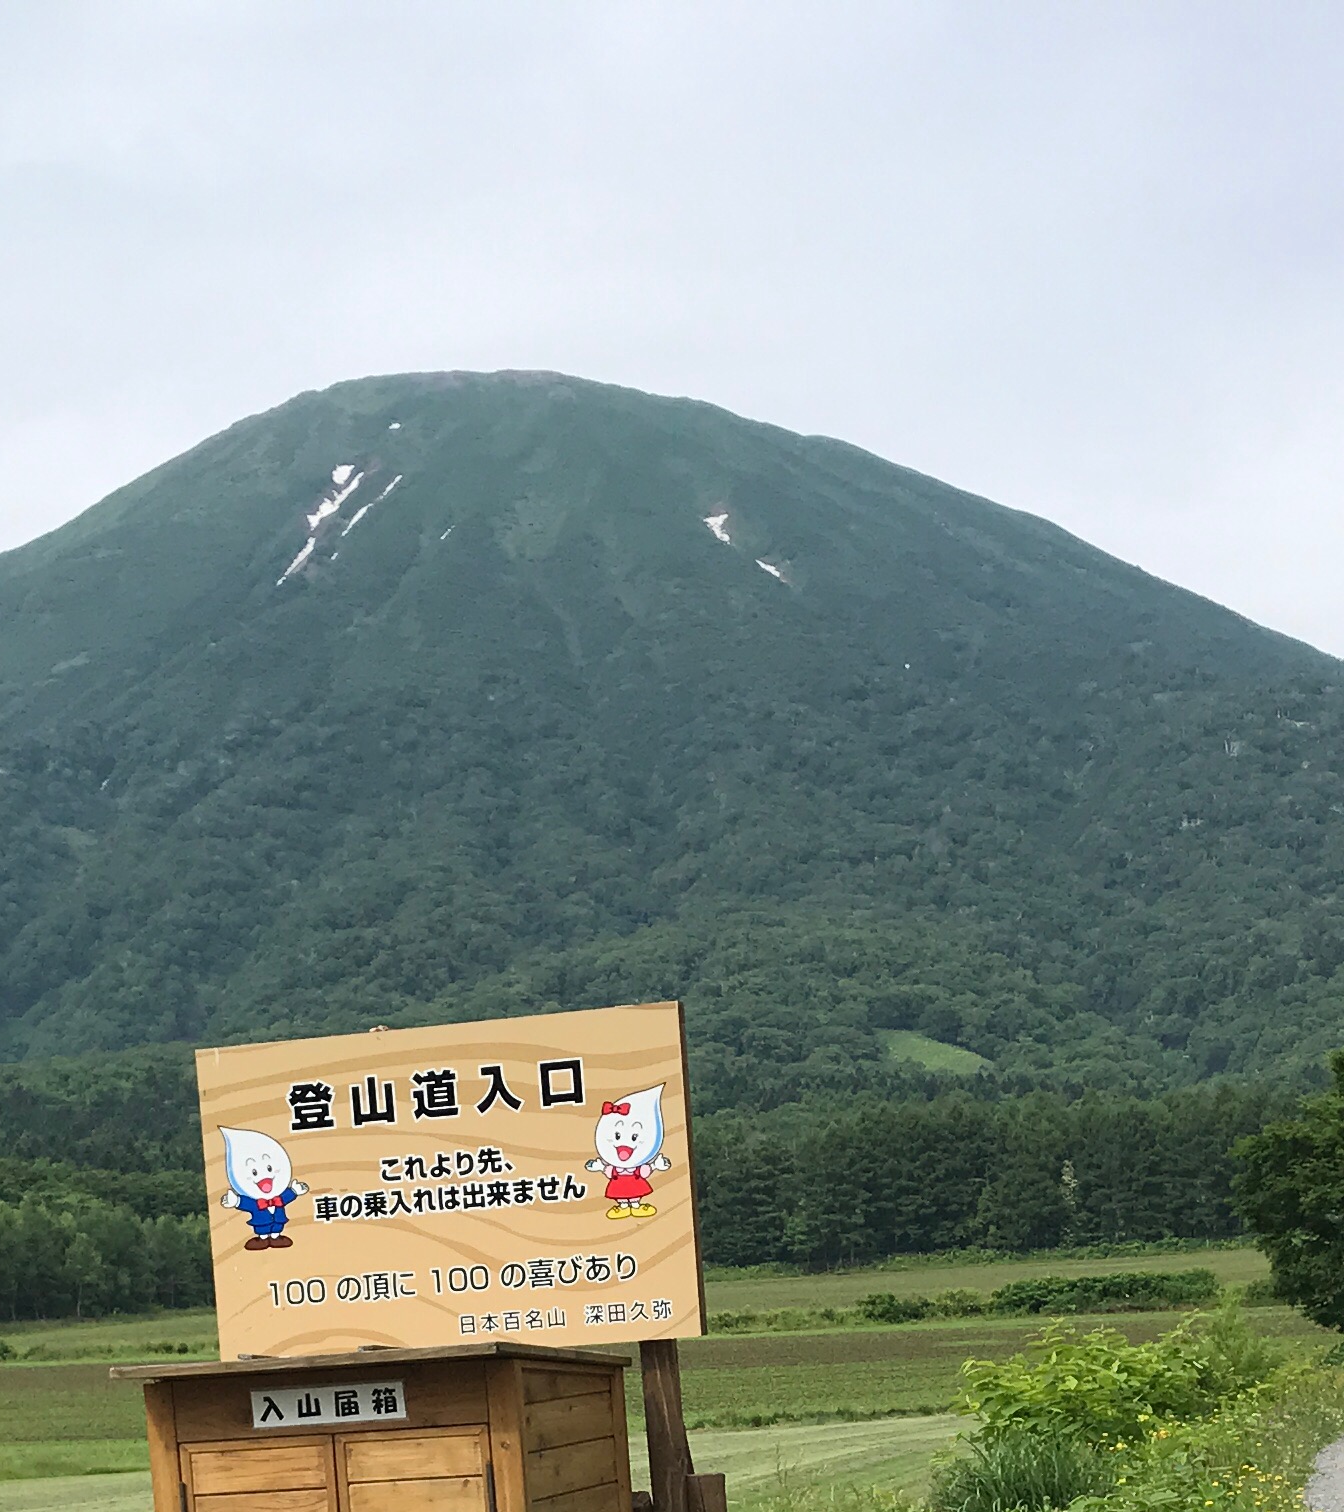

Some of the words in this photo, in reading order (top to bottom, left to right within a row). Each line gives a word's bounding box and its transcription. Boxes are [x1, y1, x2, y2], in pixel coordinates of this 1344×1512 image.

[289, 1058, 584, 1130] 登山道入口
[381, 1148, 515, 1183] これより先、
[315, 1175, 586, 1221] 車の乗入れは出来ません
[268, 1278, 325, 1306] 100
[337, 1271, 416, 1300] の頂に
[431, 1265, 489, 1294] 100
[501, 1254, 637, 1288] の喜びあり
[459, 1306, 566, 1334] 日本百名山
[585, 1300, 672, 1325] 深田久弥
[260, 1387, 401, 1422] 入山届箱
